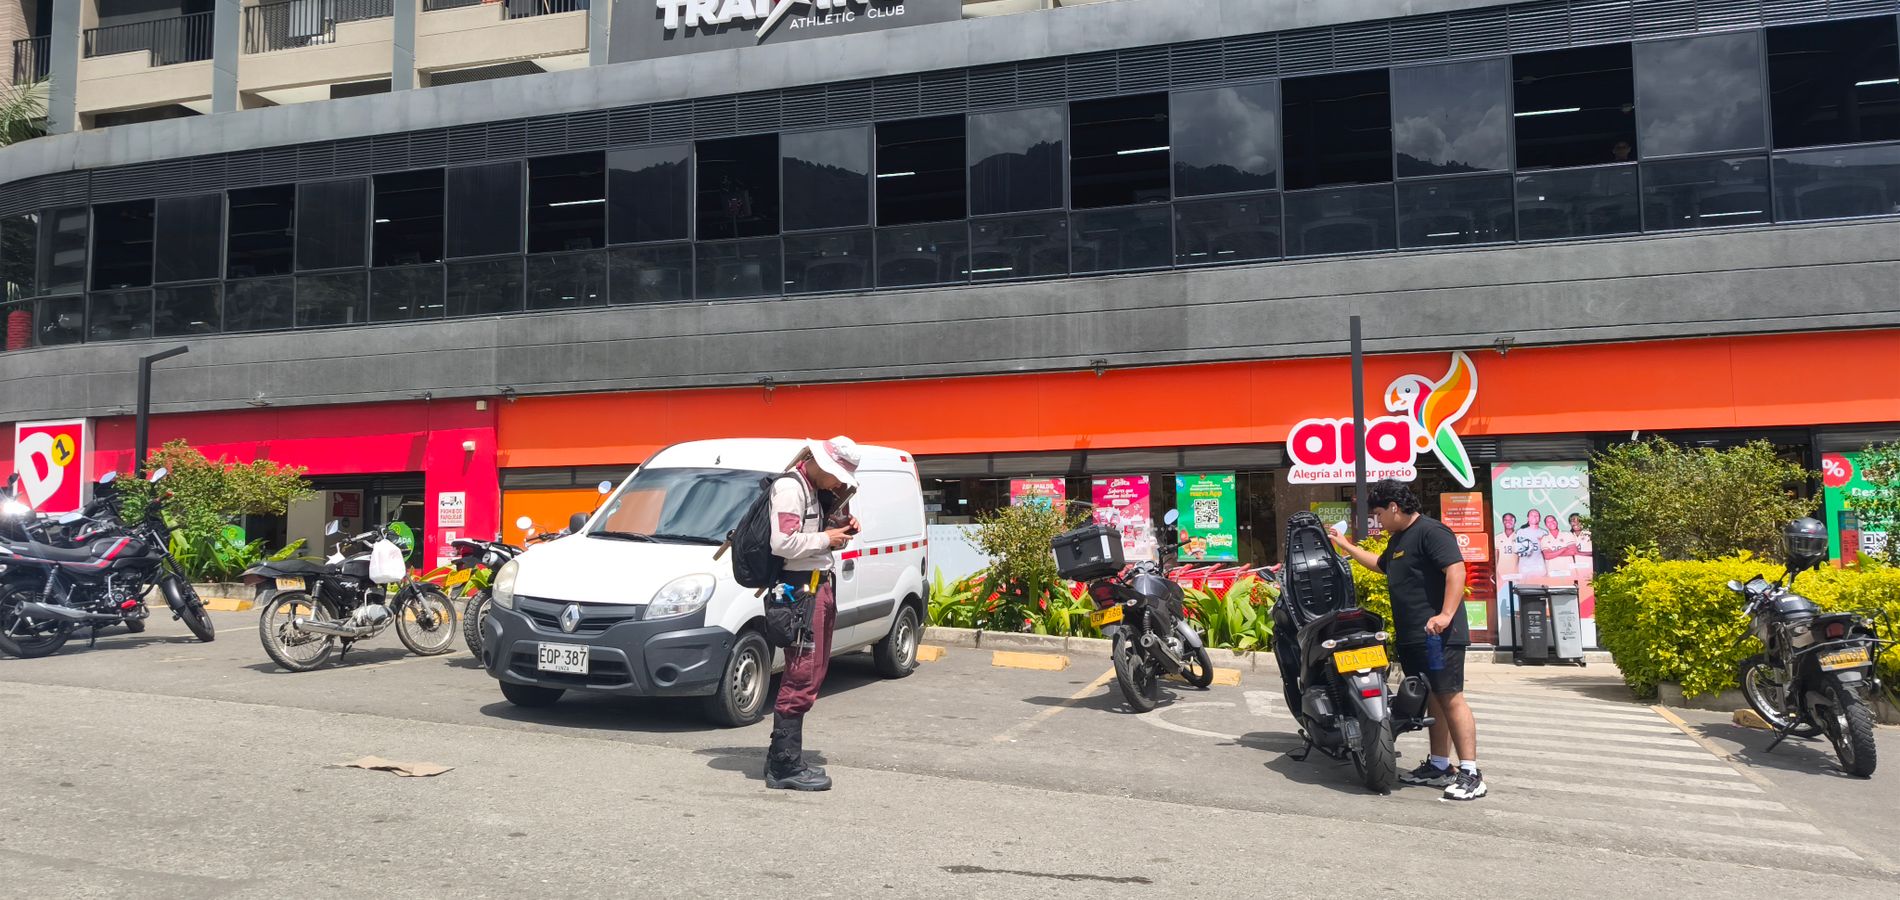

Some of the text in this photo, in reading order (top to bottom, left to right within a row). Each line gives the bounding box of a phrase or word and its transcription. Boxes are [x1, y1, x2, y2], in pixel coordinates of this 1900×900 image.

[789, 5, 905, 30] ATHLETIC CLUB
[1293, 468, 1331, 480] Alegría
[1333, 468, 1342, 478] al
[1378, 467, 1412, 480] precio
[1500, 476, 1580, 489] CREEMOS
[1318, 507, 1352, 515] PRECIO
[1503, 546, 1513, 554] 18
[564, 649, 587, 667] 387
